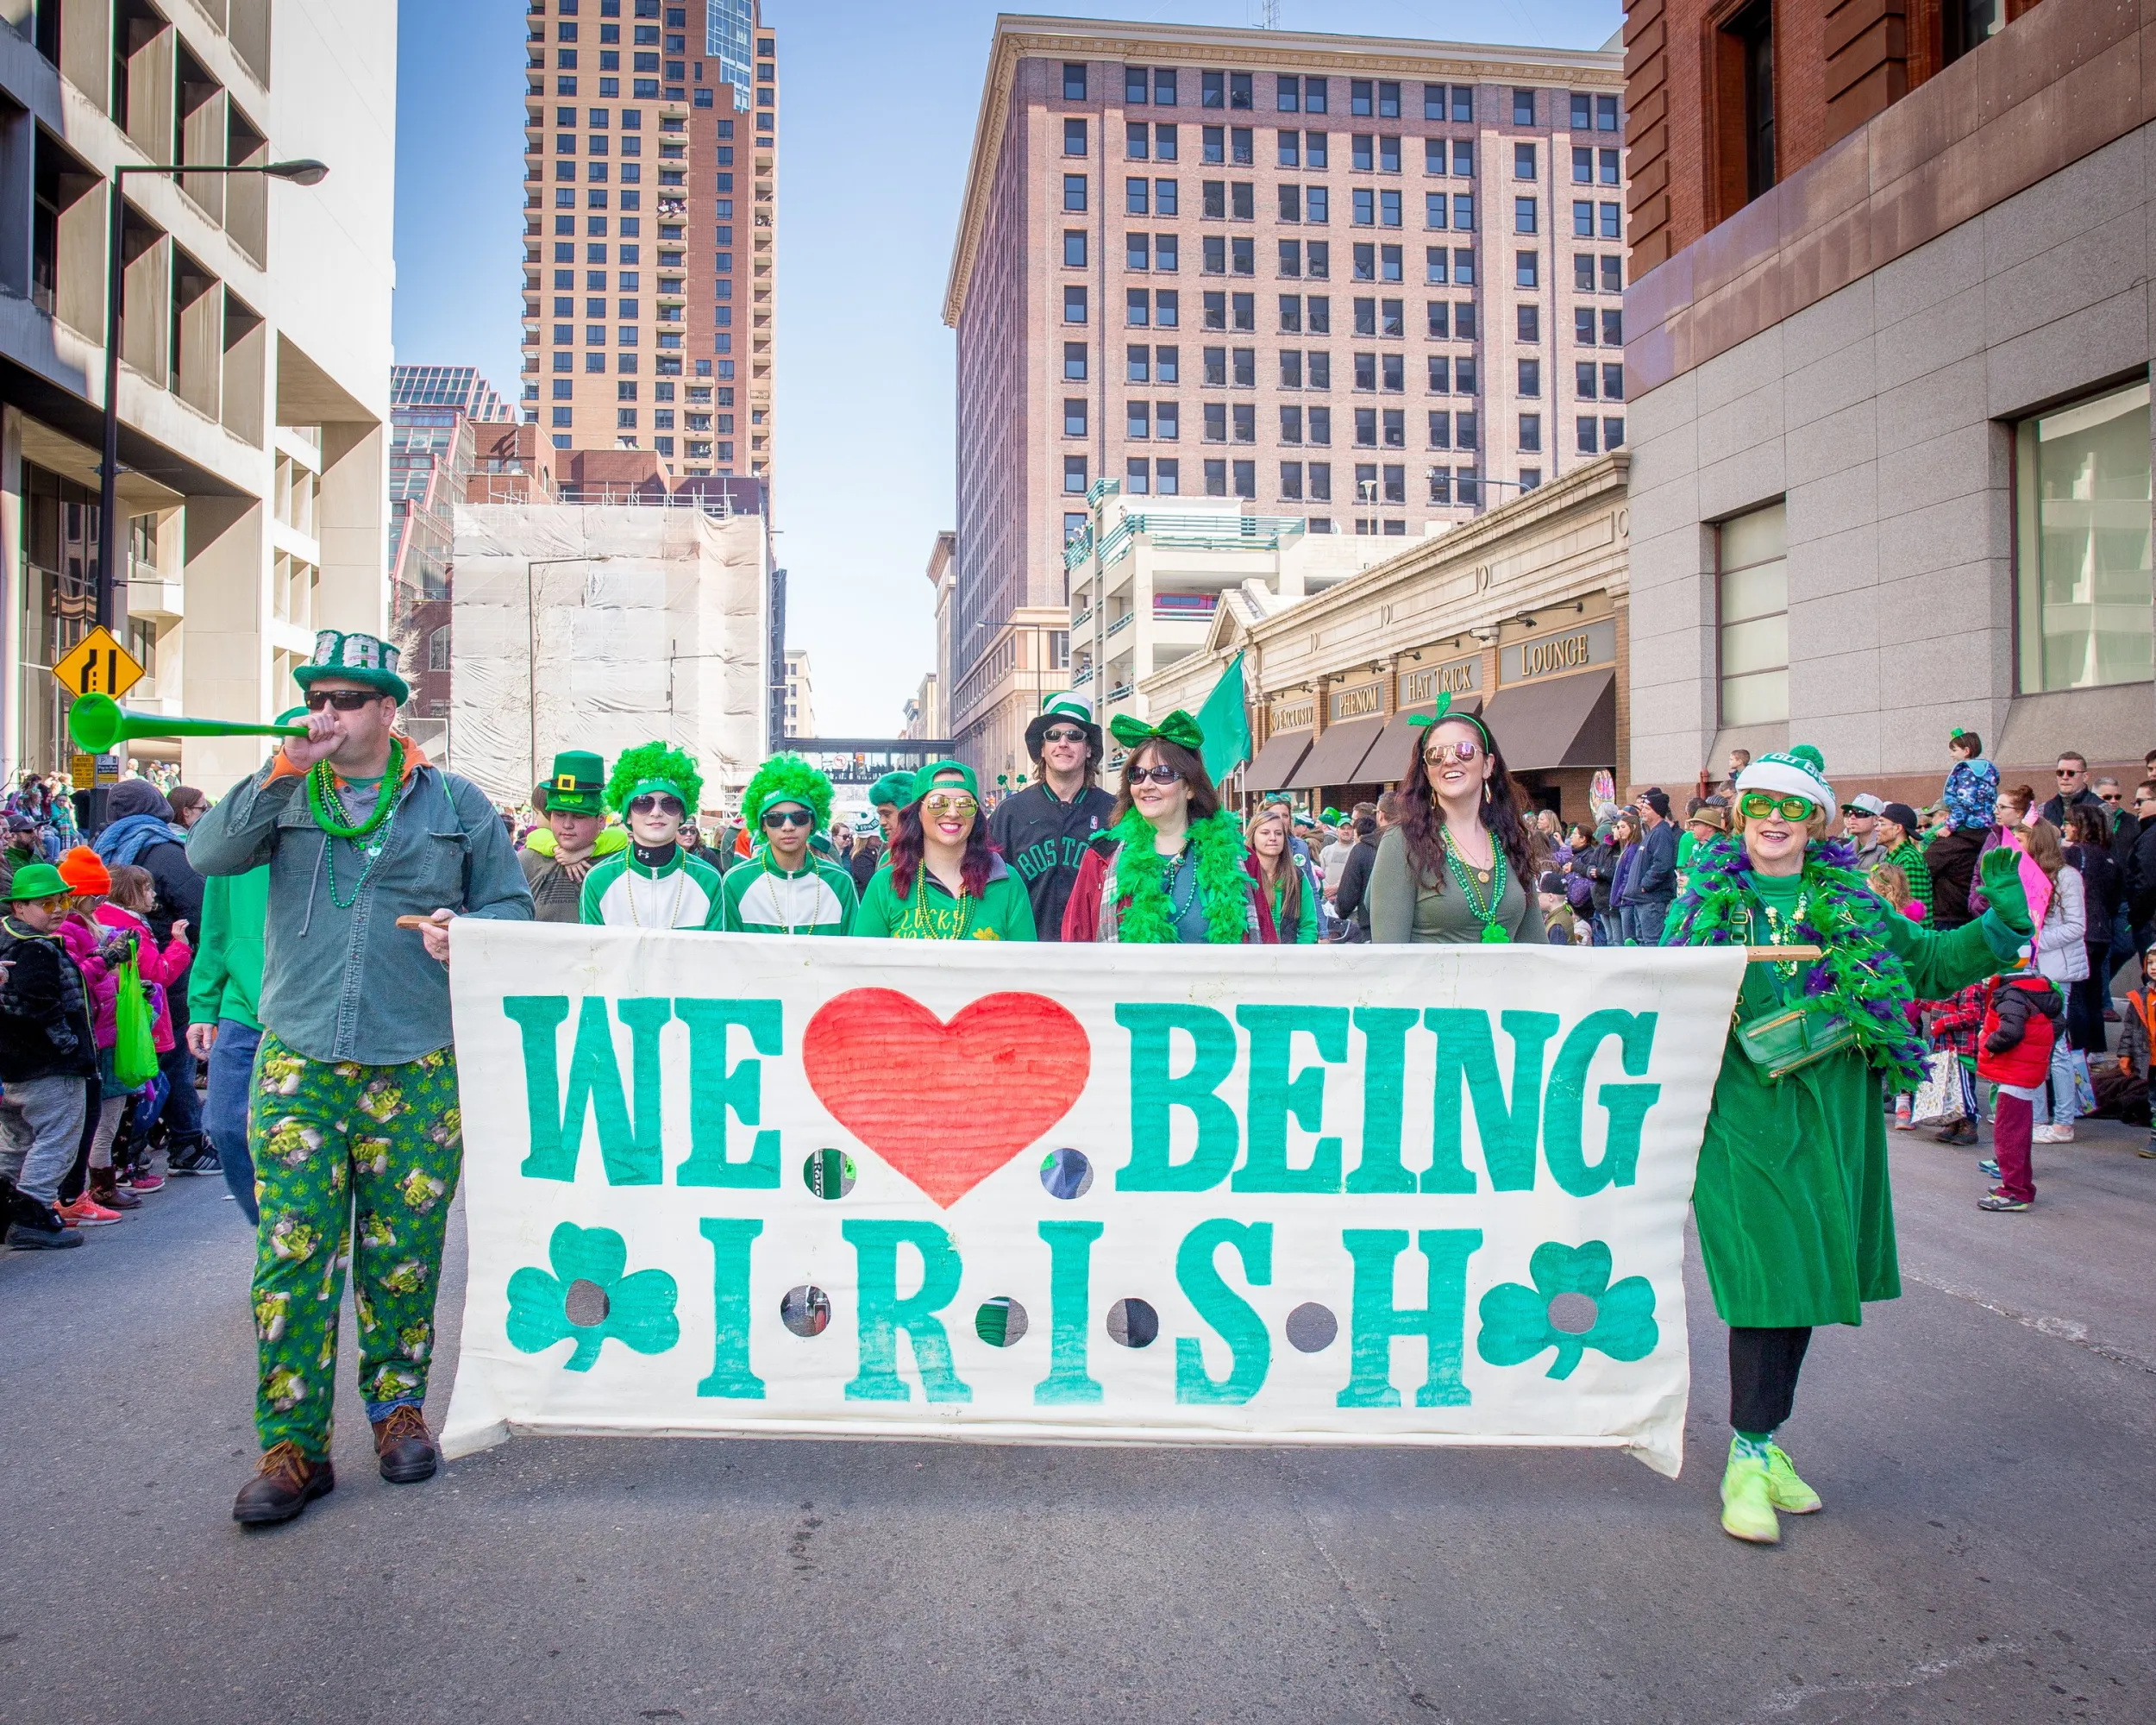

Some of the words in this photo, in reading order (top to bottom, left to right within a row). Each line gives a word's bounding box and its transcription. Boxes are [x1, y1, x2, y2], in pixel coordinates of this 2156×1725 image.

[1521, 634, 1589, 676] LOUNGE
[1338, 687, 1378, 717] PHENOM
[1408, 674, 1431, 701] HAT
[1434, 664, 1472, 694] TRICK
[1280, 706, 1313, 729] EXCLUSIV
[1017, 836, 1089, 881] BOSTO
[503, 995, 783, 1189] WE
[1114, 1002, 1661, 1198] BEING
